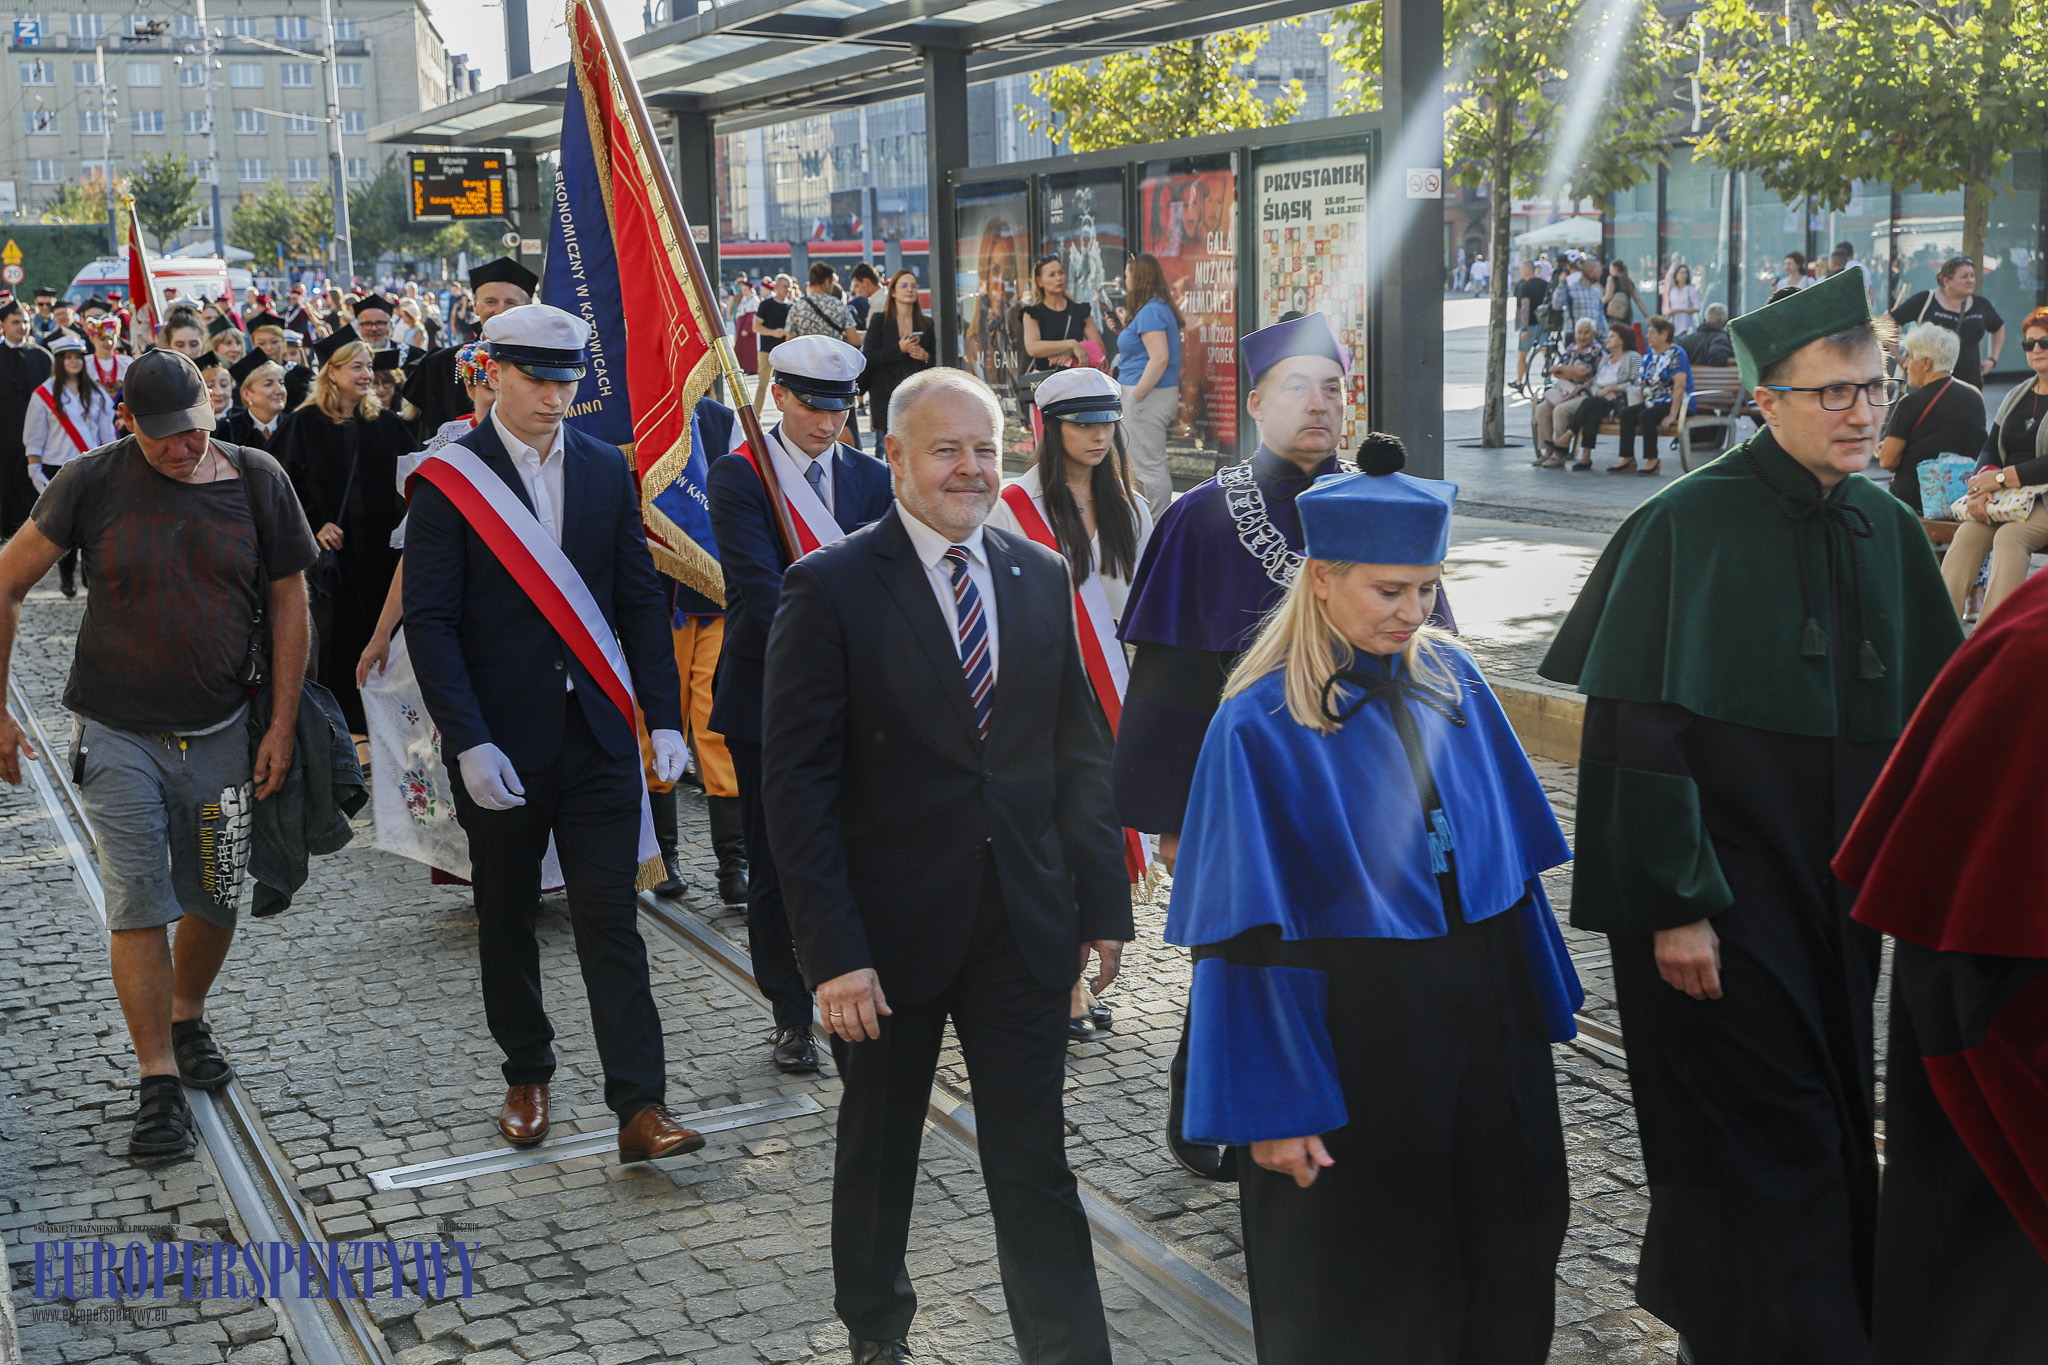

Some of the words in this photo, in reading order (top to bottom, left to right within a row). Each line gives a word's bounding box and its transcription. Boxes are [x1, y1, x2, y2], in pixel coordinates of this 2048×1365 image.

[1264, 164, 1364, 193] PRZYSTANEK
[1263, 198, 1312, 223] ŚLĄSK
[1324, 196, 1346, 206] 15.09
[555, 170, 586, 280] EKONOMICZNY
[1207, 231, 1234, 255] GALA
[1195, 260, 1234, 284] MUZYKI
[575, 283, 590, 297] W
[1184, 290, 1234, 314] FILMOWEJ
[579, 302, 613, 397] KATOWICACH
[1208, 347, 1234, 363] SPODEK
